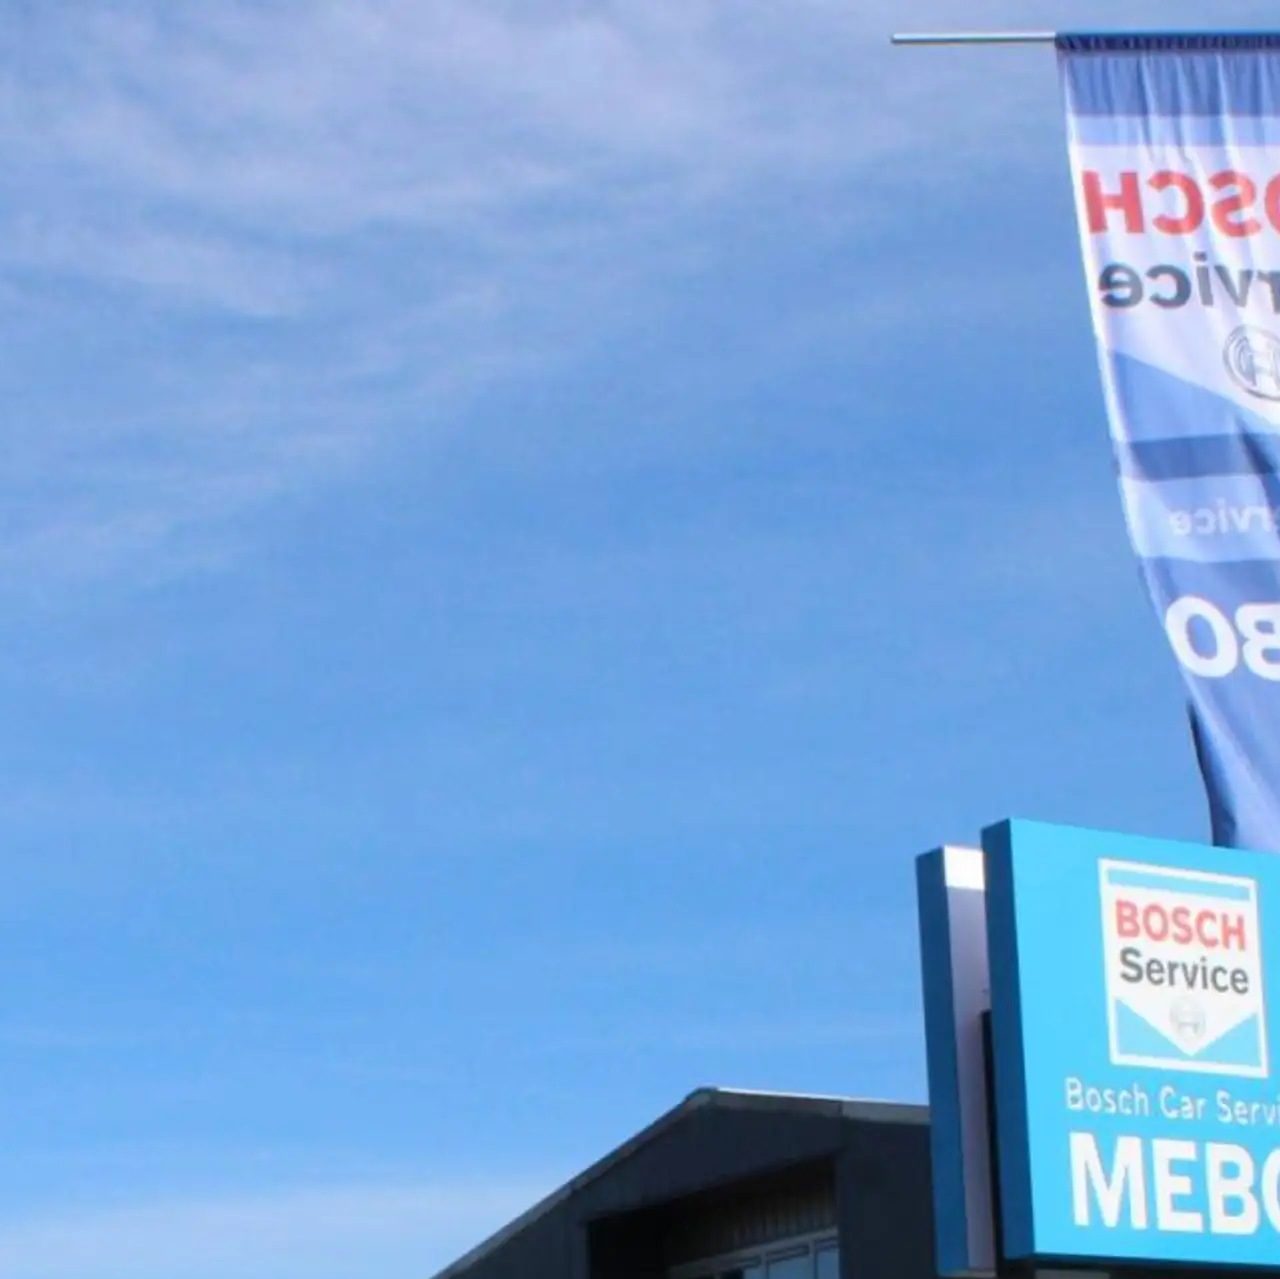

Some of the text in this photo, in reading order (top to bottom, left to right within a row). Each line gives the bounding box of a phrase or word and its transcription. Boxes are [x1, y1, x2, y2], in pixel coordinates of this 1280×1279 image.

[1114, 898, 1247, 950] BOSCH
[1119, 947, 1250, 995] Service
[1064, 1076, 1150, 1117] Bosch
[1159, 1084, 1207, 1122] Car
